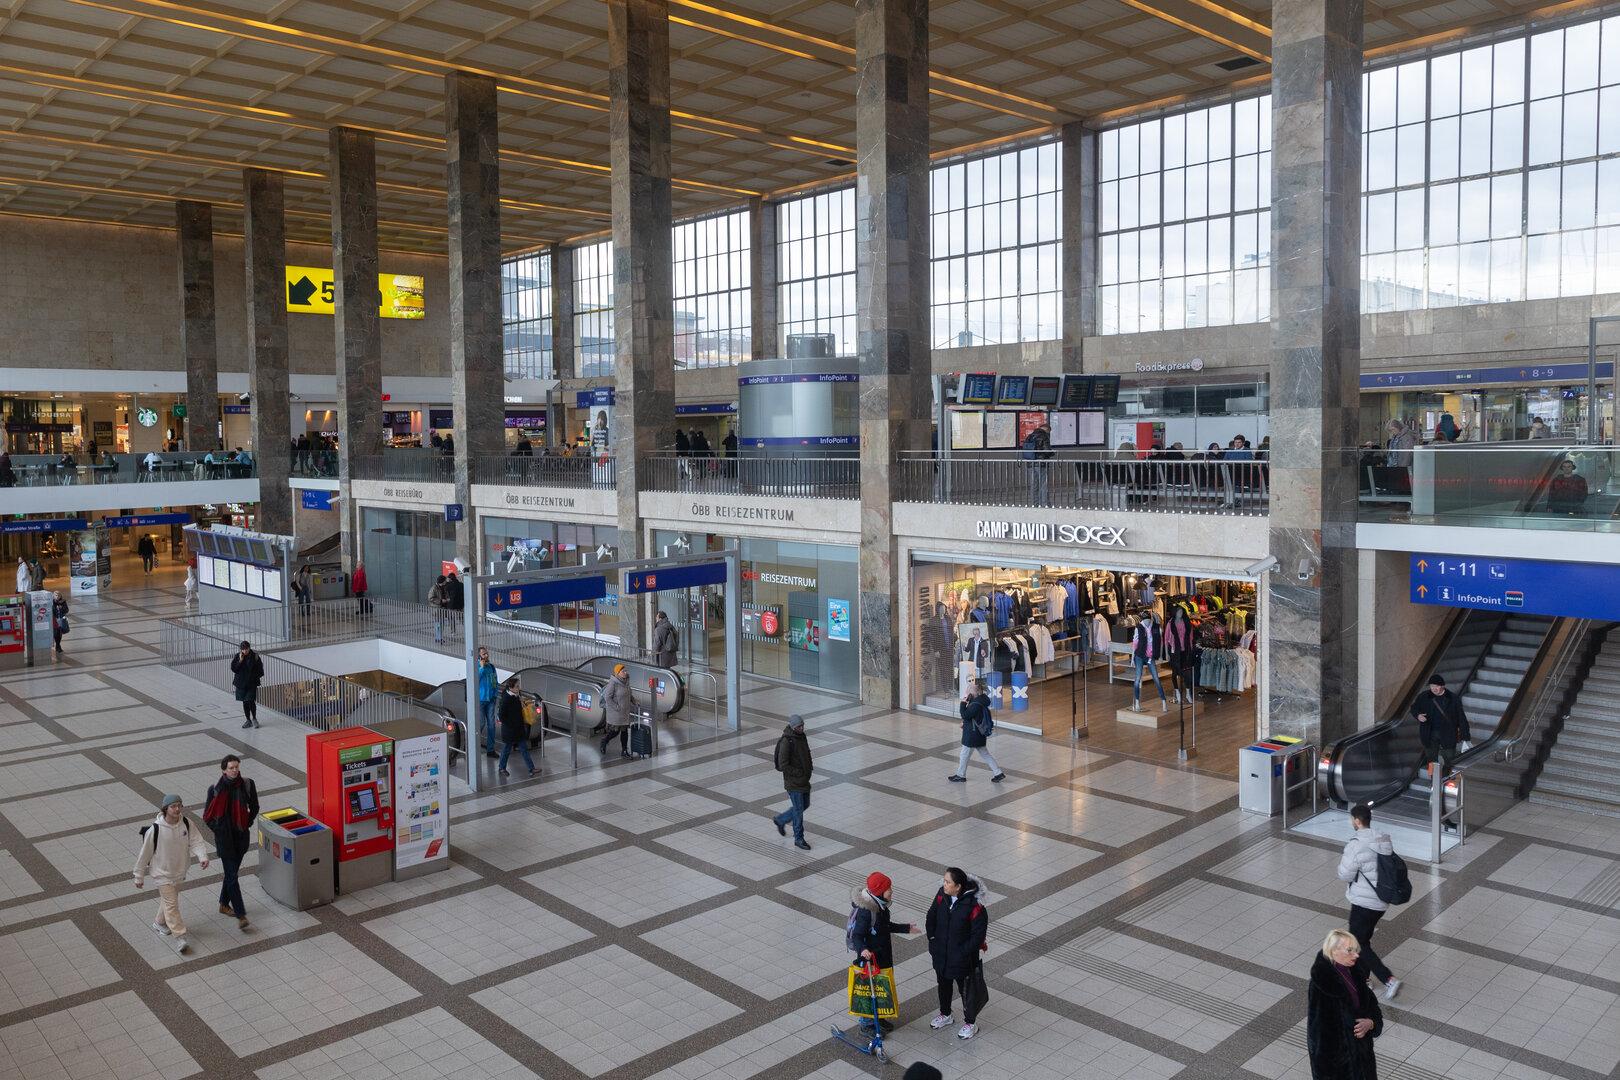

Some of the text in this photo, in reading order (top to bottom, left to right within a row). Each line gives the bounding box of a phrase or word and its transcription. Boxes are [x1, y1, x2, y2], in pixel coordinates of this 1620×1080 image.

[1135, 361, 1191, 373] FoodExpress
[819, 374, 848, 382] InfoPoint
[506, 492, 575, 508] ÖBB REISEZENTRUM
[692, 502, 795, 521] ÖBB REISEZENTRUM
[976, 520, 1009, 538] CAMP
[1012, 522, 1048, 541] DAVID
[1438, 561, 1476, 577] 1-11
[646, 577, 656, 585] U3
[760, 572, 816, 588] REISEZENTRUM
[510, 593, 520, 601] U3
[1458, 594, 1502, 604] InfoPoint
[345, 762, 366, 770] Tickets
